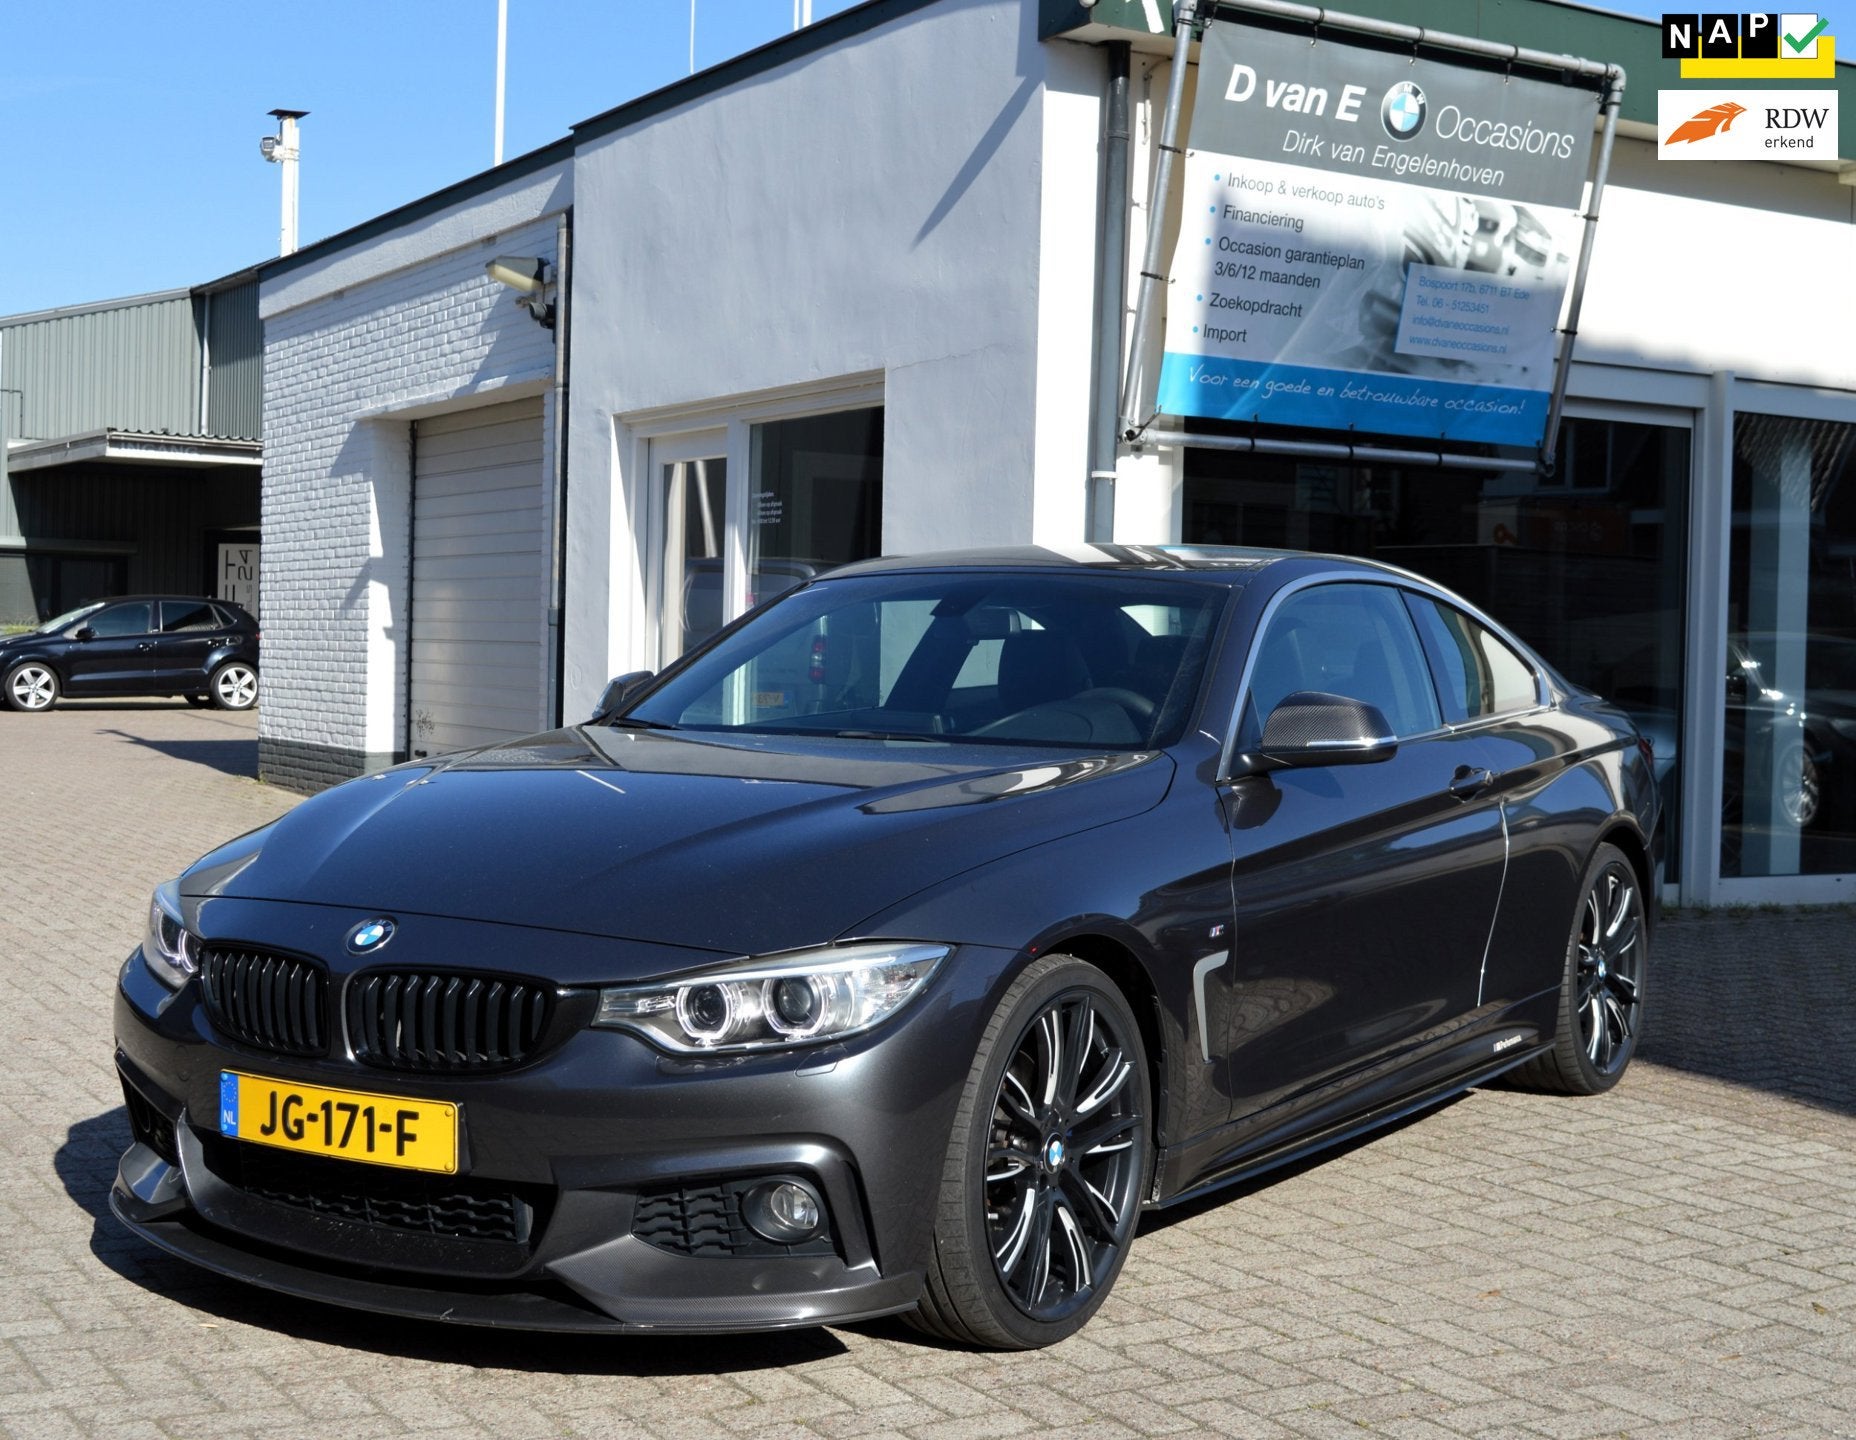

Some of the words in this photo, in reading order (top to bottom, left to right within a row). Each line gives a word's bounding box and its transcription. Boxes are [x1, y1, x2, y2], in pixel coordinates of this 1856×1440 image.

[1224, 64, 1256, 102] D
[1266, 79, 1327, 118] van
[1335, 85, 1366, 122] E
[1436, 105, 1574, 159] Occasions
[1283, 130, 1323, 159] Dirk
[1331, 143, 1365, 165] van
[1372, 145, 1504, 187] Engelenhoven
[1228, 173, 1273, 194] Inkoop
[1278, 180, 1286, 194] &
[1292, 183, 1343, 205] verkoop
[1347, 194, 1385, 210] auto's
[1223, 205, 1304, 232] Financiering
[1219, 236, 1281, 259] Occasion
[1285, 245, 1365, 270] garantieplan
[1214, 261, 1256, 280] 3/6/12
[1260, 269, 1320, 288] maanden
[1419, 276, 1457, 291] Bospoort
[1210, 292, 1303, 317] Zoekopdracht
[1432, 298, 1443, 308] 06
[1203, 324, 1247, 343] Import
[1189, 364, 1228, 386] Voor
[1233, 377, 1259, 389] een
[1261, 379, 1312, 399] goede
[1317, 386, 1335, 396] en
[1339, 381, 1438, 407] betrouwbare
[1444, 399, 1525, 415] occasion!
[223, 1110, 236, 1126] NL
[260, 1090, 420, 1157] JG-171-F
